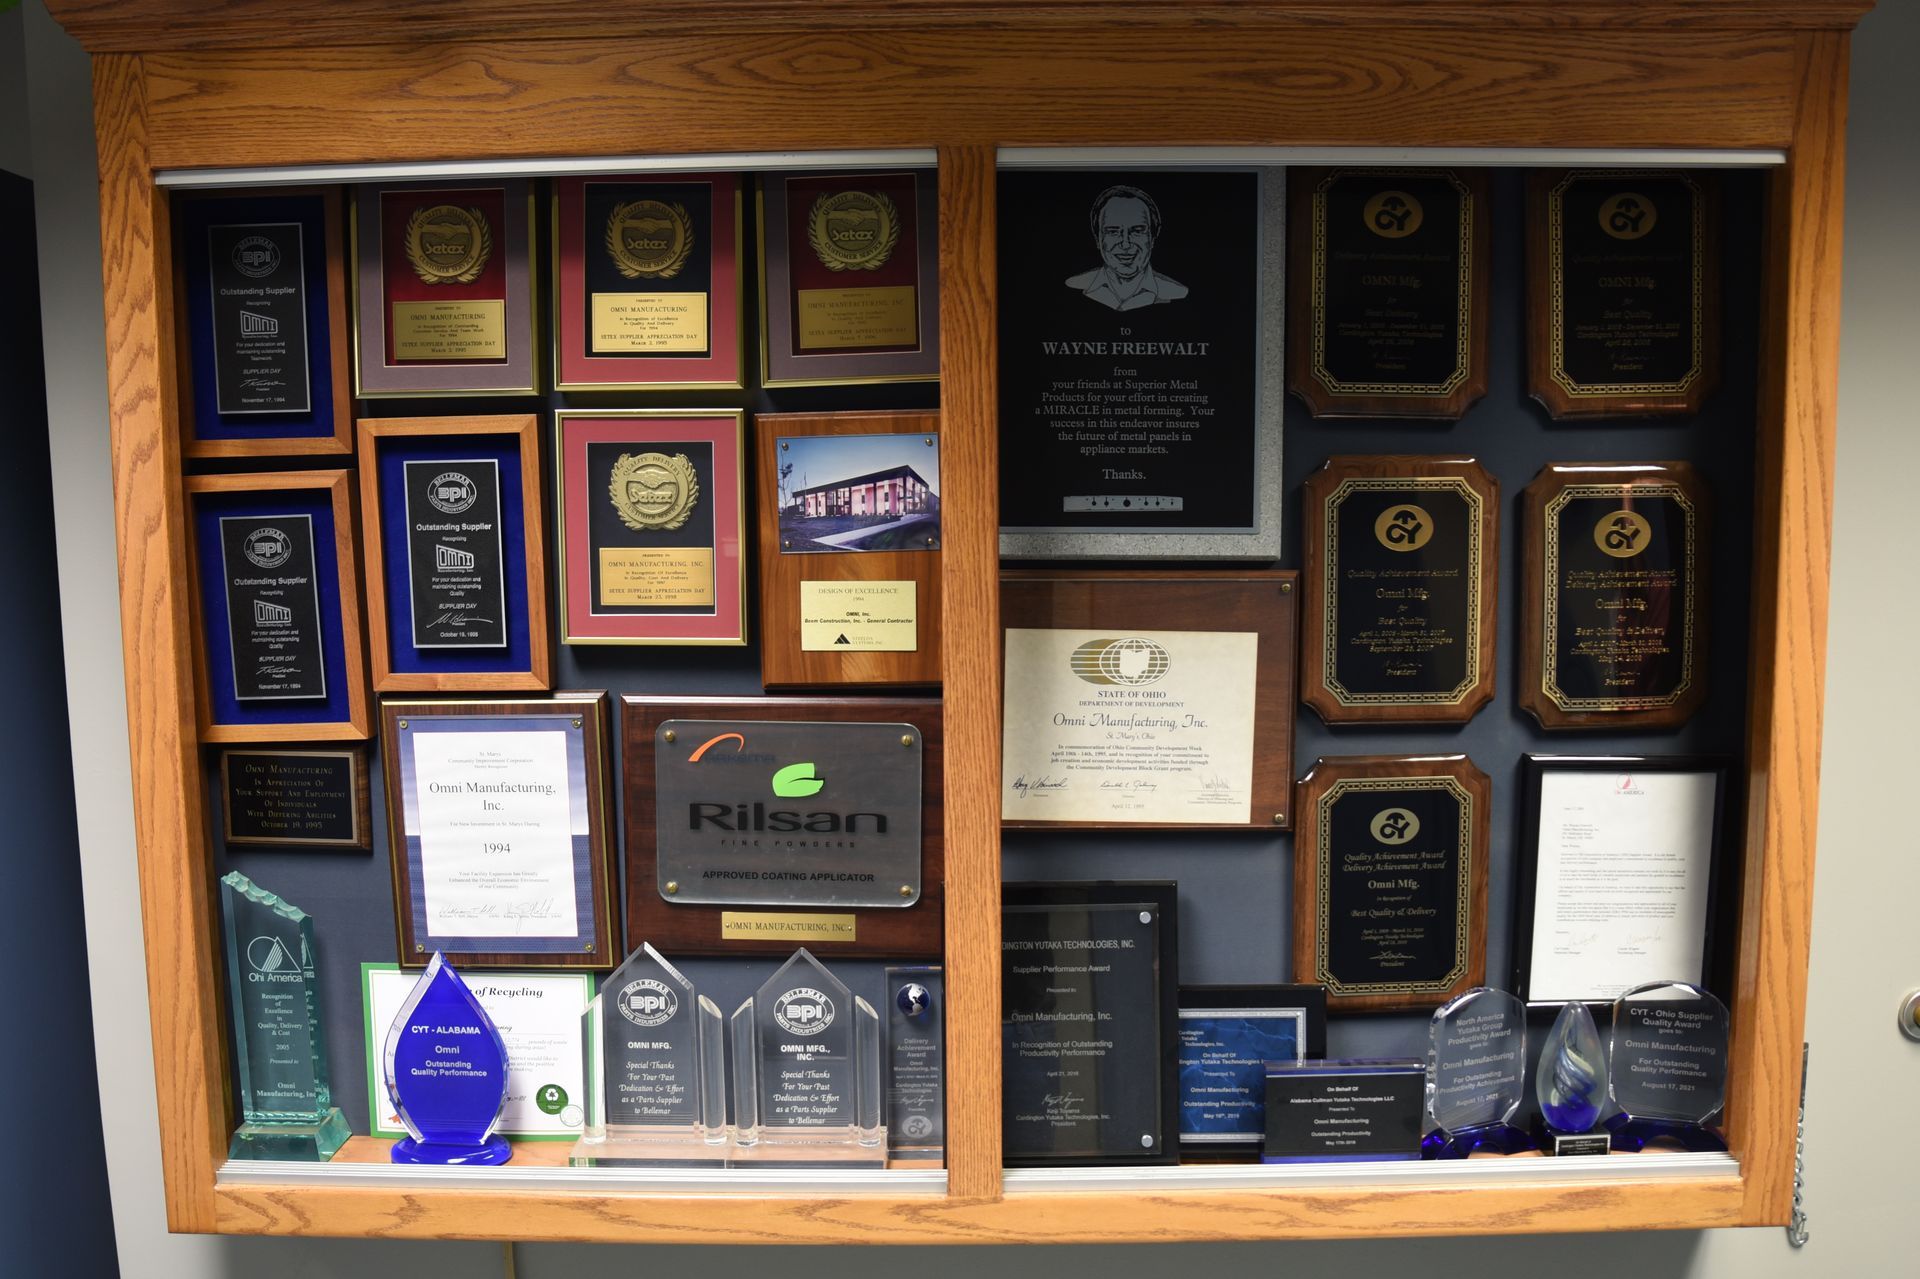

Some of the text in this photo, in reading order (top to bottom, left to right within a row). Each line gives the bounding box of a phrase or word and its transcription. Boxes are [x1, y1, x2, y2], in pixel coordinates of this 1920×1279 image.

[243, 252, 271, 266] BPI
[220, 287, 297, 297] Outstanding Supplier
[430, 313, 486, 321] MANUFACTURING
[1121, 326, 1131, 336] to
[1042, 342, 1209, 355] WAYNE FREEWALT
[1114, 367, 1138, 376] from
[1052, 380, 1199, 391] your friends at Superior Metal
[1042, 392, 1209, 404] Products for your effort in creating
[1043, 405, 1101, 415] MIRACLE
[1102, 406, 1112, 415] in
[1114, 405, 1142, 415] metal
[1143, 405, 1186, 418] forming.
[1190, 406, 1216, 416] Your
[1087, 418, 1097, 428] in
[1099, 418, 1117, 428] this
[1119, 418, 1164, 429] endeavor
[1165, 419, 1200, 429] insures
[1058, 431, 1192, 443] the future of metal panels in
[1080, 444, 1169, 456] appliance markets.
[1102, 469, 1147, 480] Thanks.
[437, 487, 467, 503] BPI
[416, 523, 492, 532] Outstanding Supplier
[234, 577, 308, 586] Outstanding Supplier
[1097, 690, 1167, 699] STATE OF OHIO
[1053, 712, 1208, 731] Omni Manufacturing, Inc.
[270, 764, 333, 775] MANUFACTURING
[429, 781, 556, 796] Omni Manufacturing,
[483, 799, 505, 811] Inc.
[689, 802, 888, 834] Rilsan
[483, 842, 511, 854] 1994
[774, 840, 856, 848] POWDERS
[1344, 850, 1447, 863] Quality Achievement Award
[1343, 861, 1447, 873] Delivery Achievement Award
[702, 870, 875, 882] APPROVED COATING APPLICATOR
[1368, 880, 1420, 890] Omni Mfg.
[729, 923, 754, 932] OMNI
[755, 923, 830, 932] MANUFACTURING,
[1034, 940, 1062, 950] YUTAKA
[1063, 939, 1120, 950] TECHNOLOGIES,
[1120, 939, 1136, 949] INC.
[1012, 964, 1112, 974] Supplier Performance Award
[248, 972, 304, 983] Ohi America
[475, 986, 544, 998] of Recycling
[630, 996, 666, 1013] BPI
[786, 1004, 822, 1022] BPI
[1011, 1011, 1113, 1022] Omni Manufacturing, Inc.
[1630, 1007, 1714, 1021] CYT Ohio Supplier
[1456, 1013, 1505, 1027] North America
[1642, 1017, 1702, 1030] Quality Award
[258, 1022, 304, 1030] Quality, Delivery
[411, 1026, 481, 1034] CYT ALABAMA
[1457, 1022, 1503, 1035] Yutaka Group
[1447, 1028, 1512, 1046] Productivity Award
[435, 1045, 460, 1054] Omni
[627, 1042, 673, 1050] OMNI MFG.
[780, 1044, 805, 1053] OMNI
[1624, 1040, 1716, 1055] Omni Manufacturing
[797, 1053, 815, 1061] INC.
[425, 1060, 472, 1070] Outstanding
[625, 1061, 676, 1071] Special Thanks
[1638, 1057, 1700, 1070] For Outstanding
[411, 1068, 488, 1078] Quality Performance
[780, 1069, 831, 1079] Special Thanks
[1630, 1064, 1707, 1077] Quality Performance
[618, 1085, 653, 1093] Dedication
[665, 1085, 685, 1095] Effort
[1640, 1081, 1666, 1090] August
[1679, 1083, 1695, 1091] 2021
